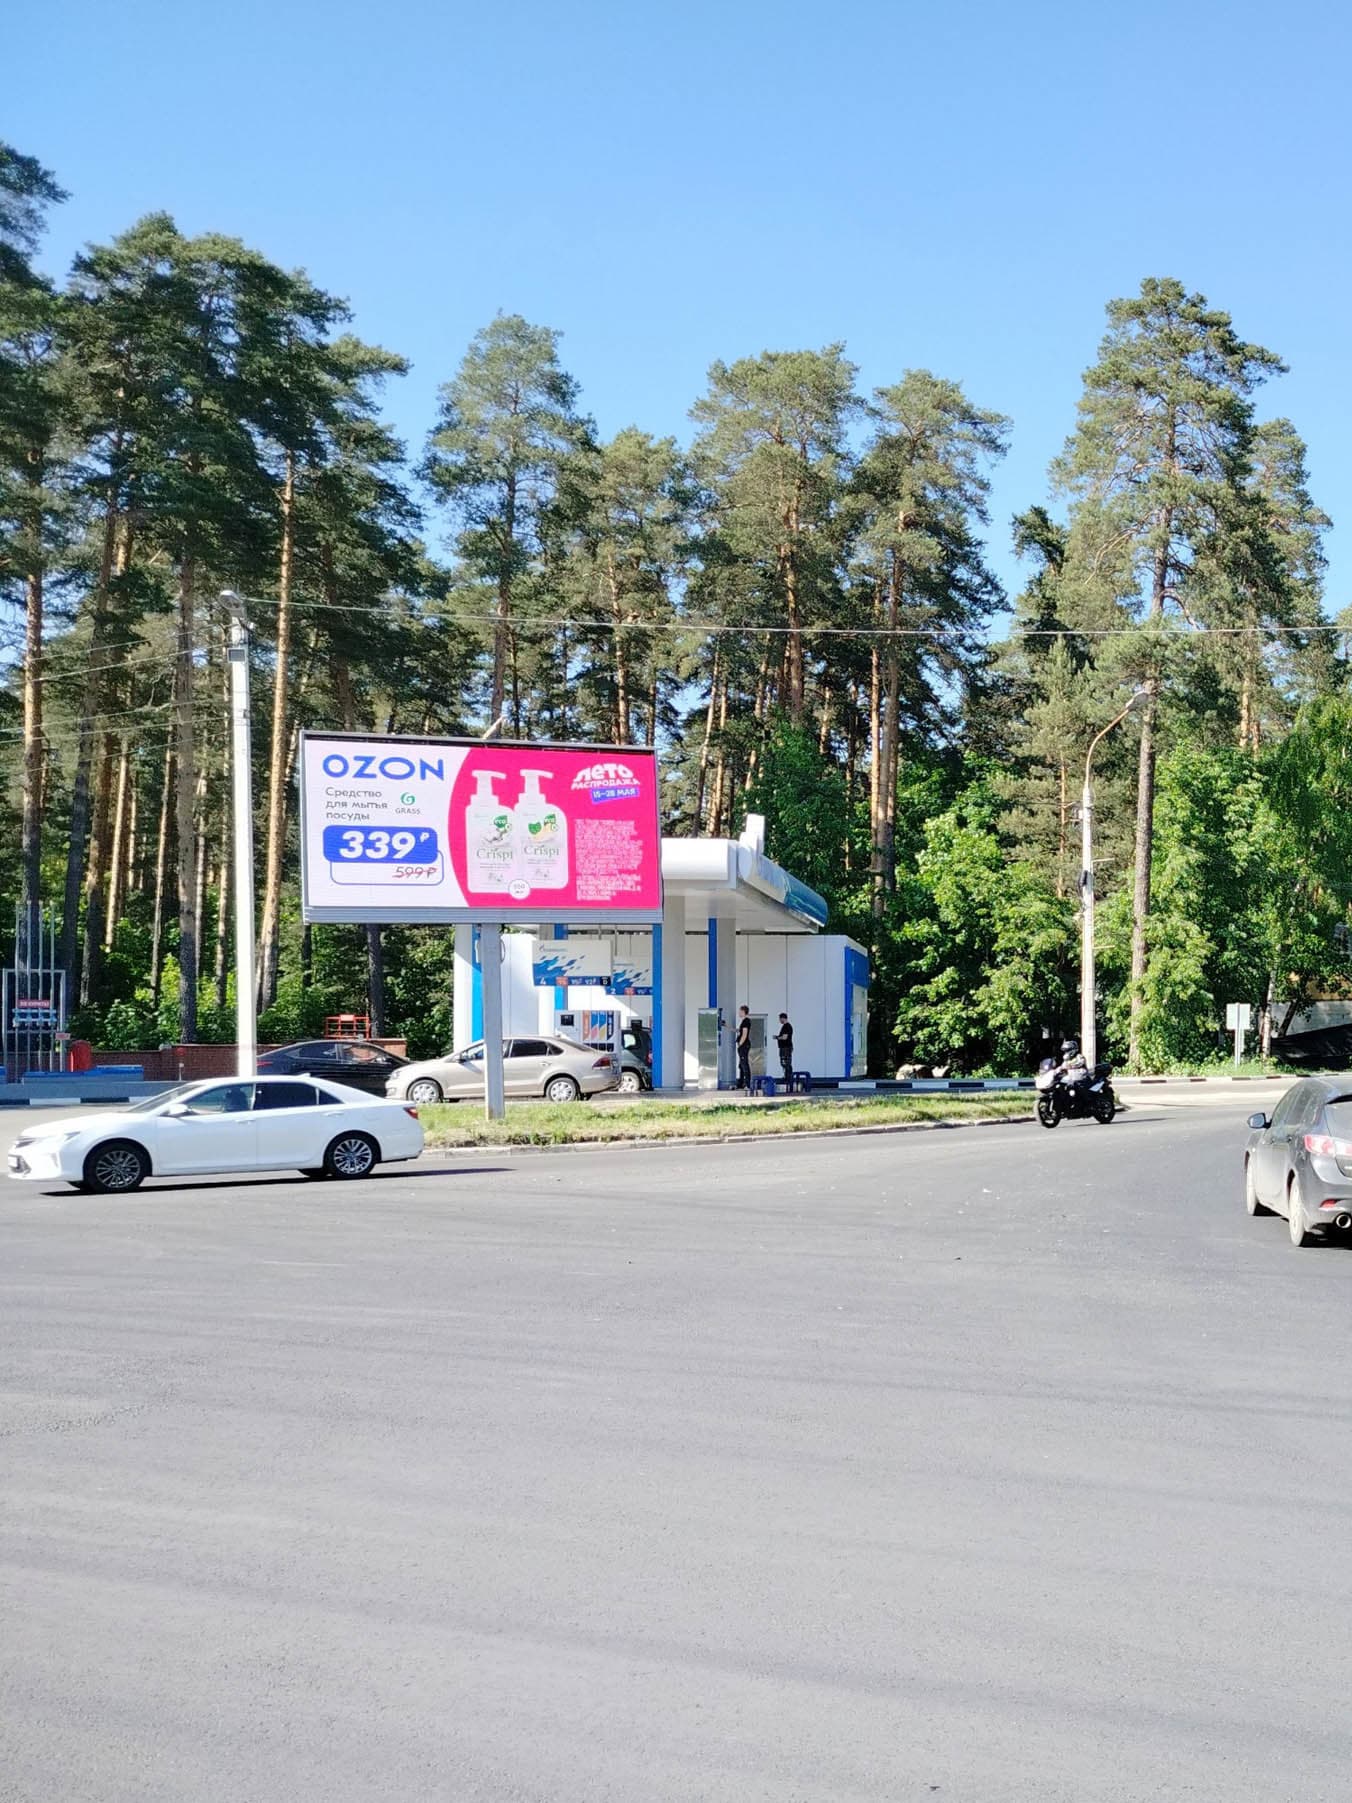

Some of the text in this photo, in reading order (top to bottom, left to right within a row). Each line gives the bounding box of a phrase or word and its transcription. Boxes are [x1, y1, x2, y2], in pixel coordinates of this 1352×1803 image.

[322, 754, 444, 781] OZON
[325, 786, 382, 798] Средство
[325, 800, 388, 809] для мытья
[395, 807, 421, 815] GRASS
[326, 812, 370, 821] посуды
[338, 830, 416, 859] 339
